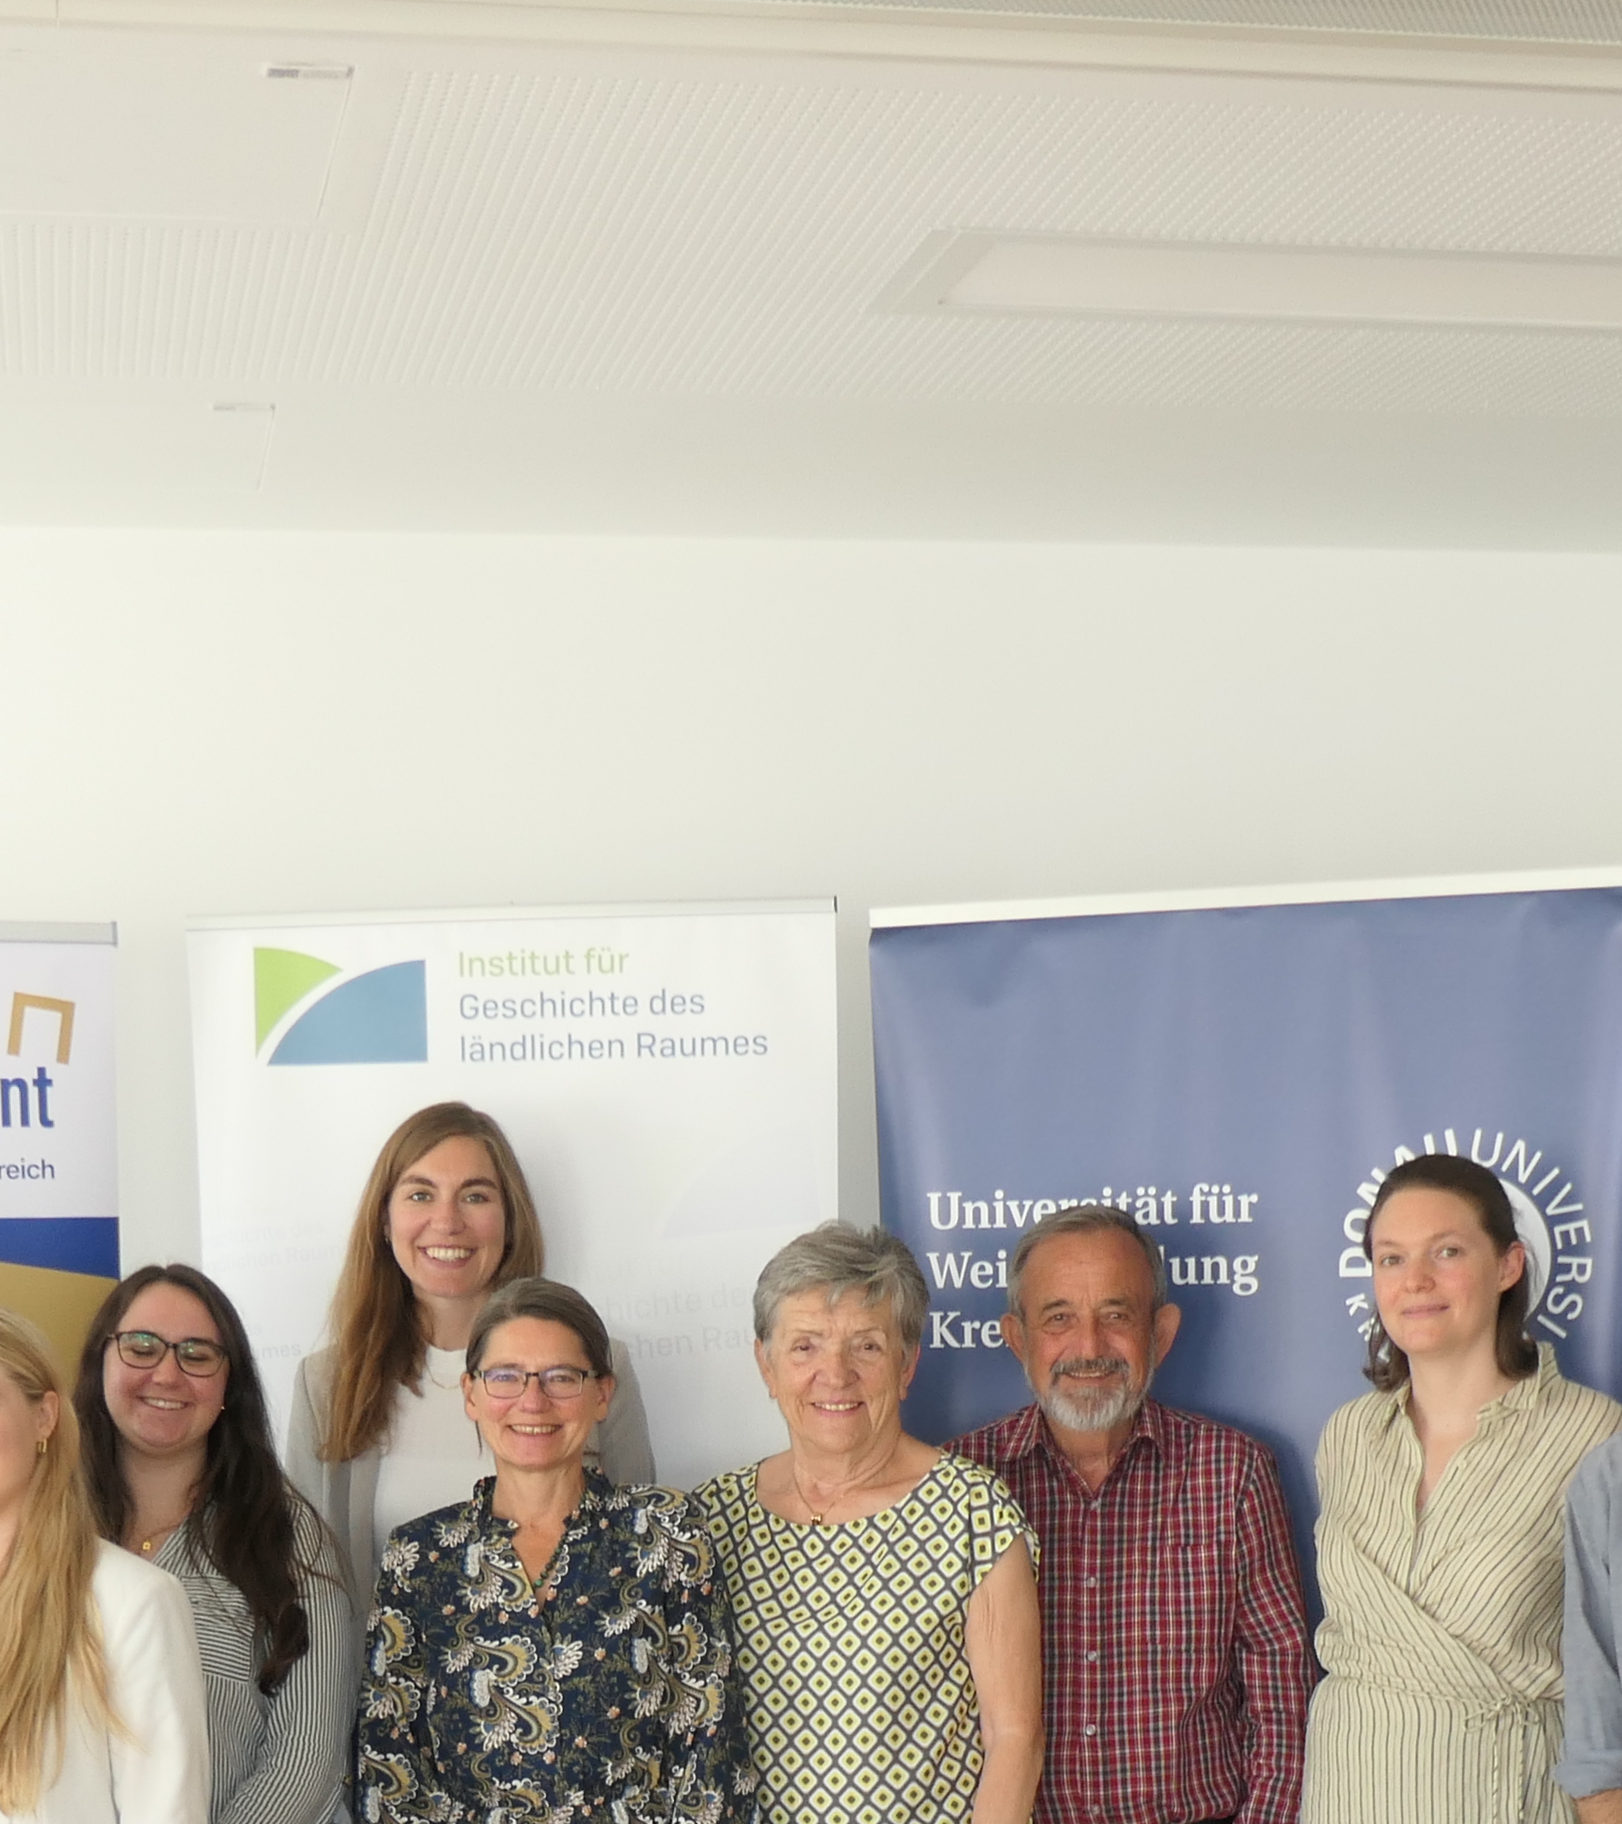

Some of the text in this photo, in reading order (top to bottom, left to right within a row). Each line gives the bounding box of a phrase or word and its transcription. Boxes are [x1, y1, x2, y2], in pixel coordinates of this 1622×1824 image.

[458, 947, 629, 978] Institut für
[459, 988, 706, 1020] Geschichte des
[460, 1032, 769, 1063] ländlichen Raumes
[1189, 1182, 1259, 1225] für
[1470, 1128, 1593, 1338] UNIVERSI
